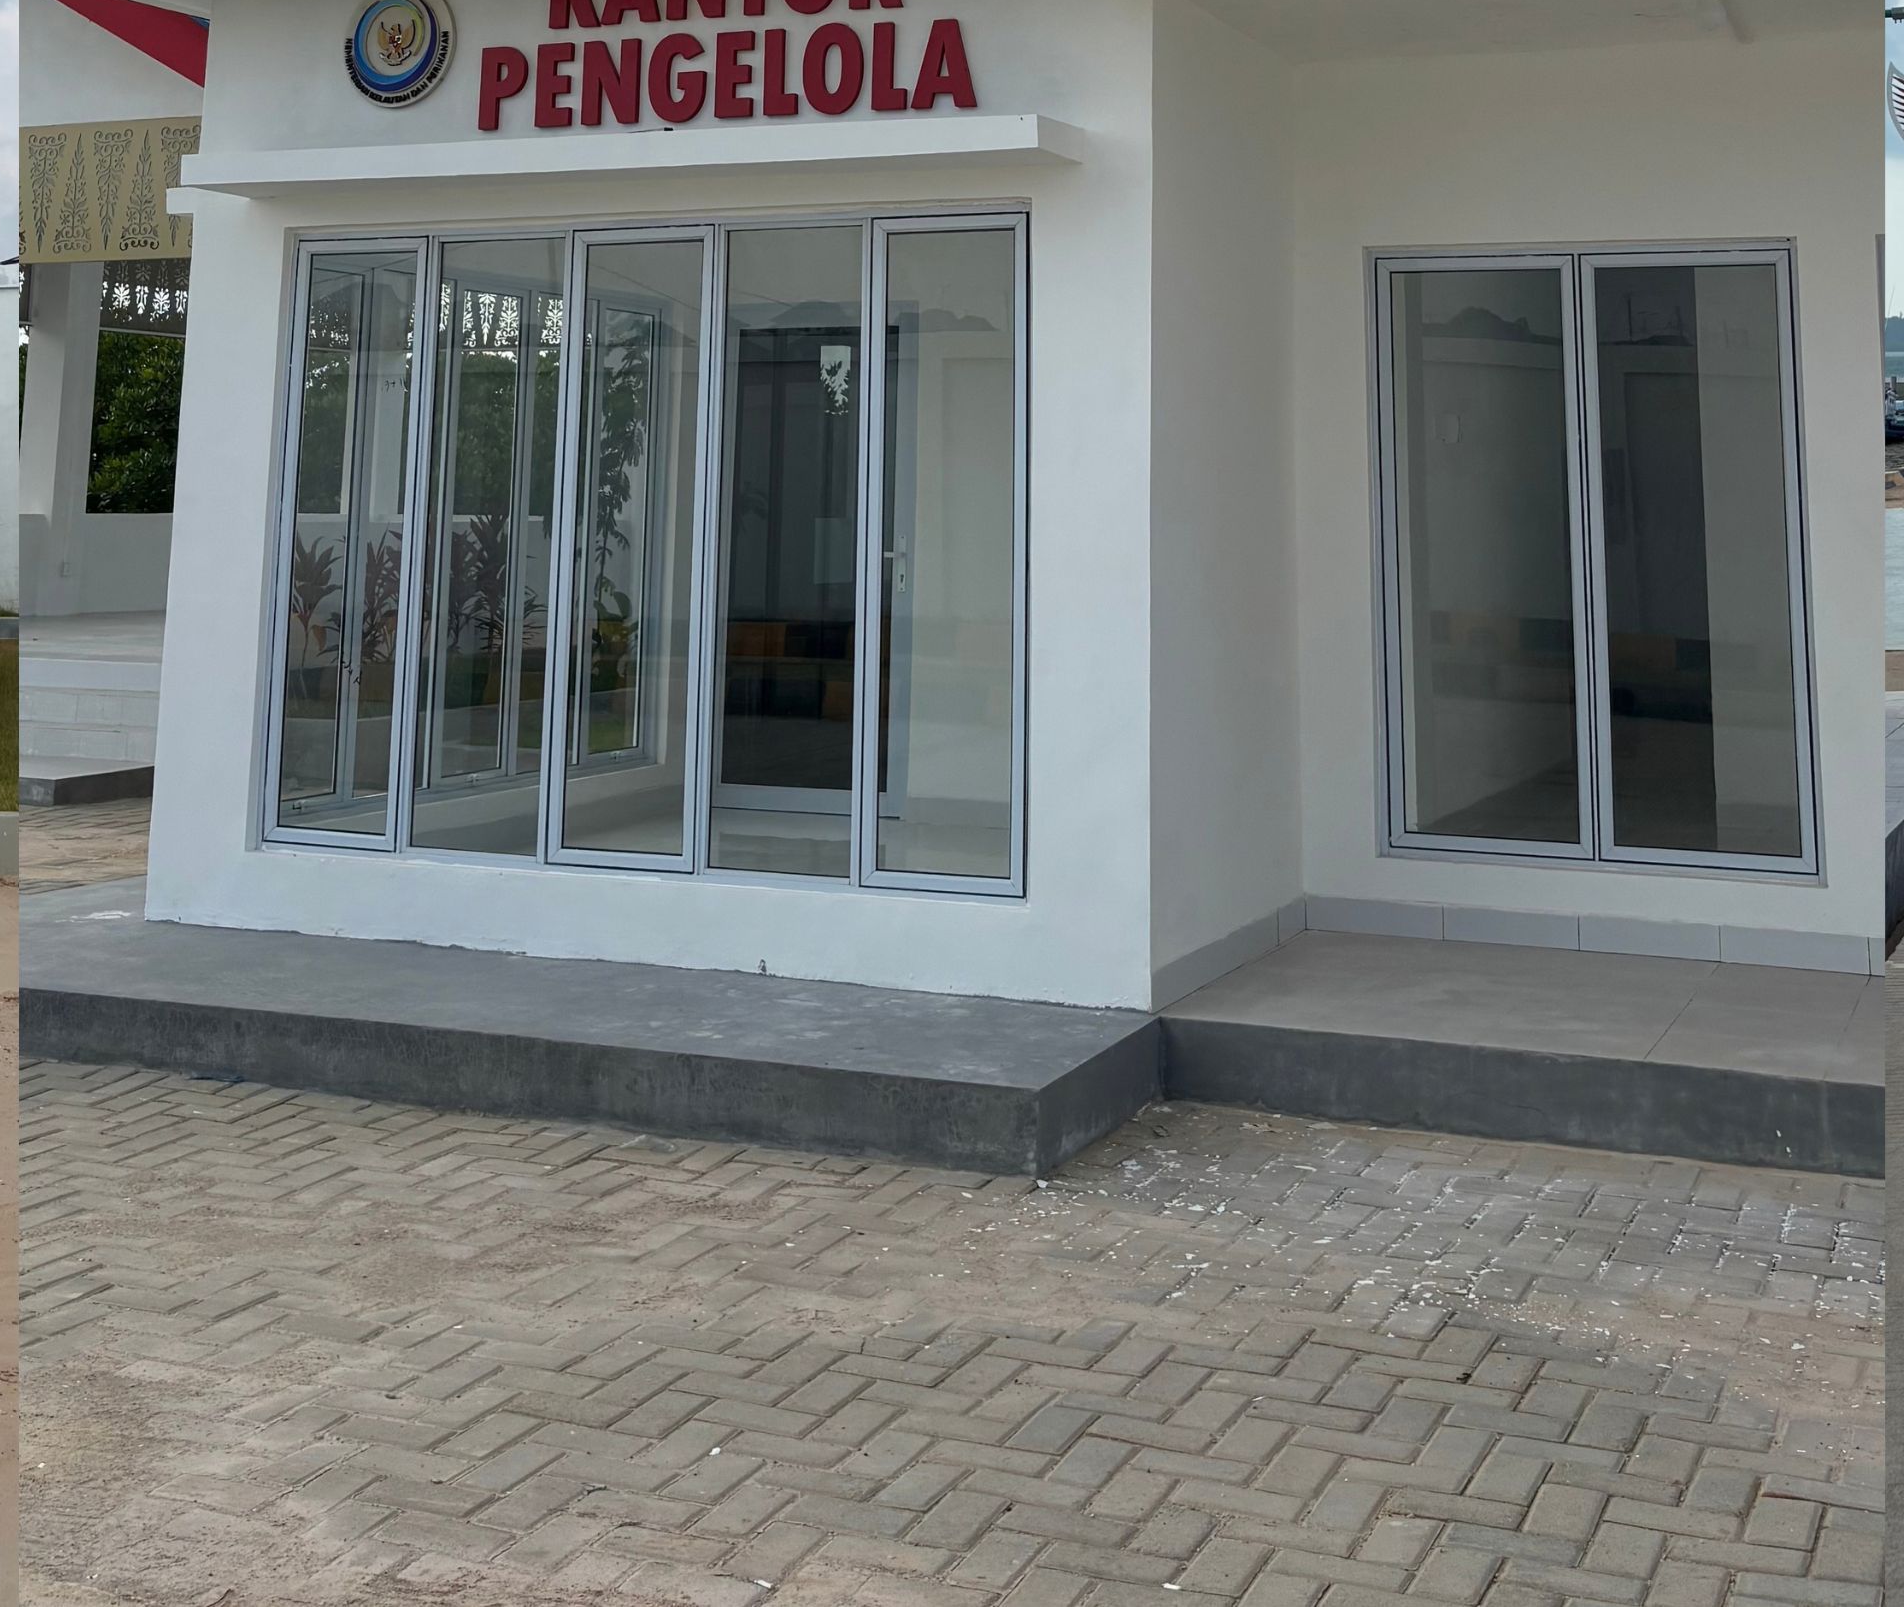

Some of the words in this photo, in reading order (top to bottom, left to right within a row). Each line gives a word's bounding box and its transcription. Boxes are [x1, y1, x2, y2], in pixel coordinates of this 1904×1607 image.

[411, 81, 430, 98] DAN
[426, 30, 450, 84] PERIKANAN
[477, 18, 978, 131] PENGELOLA
